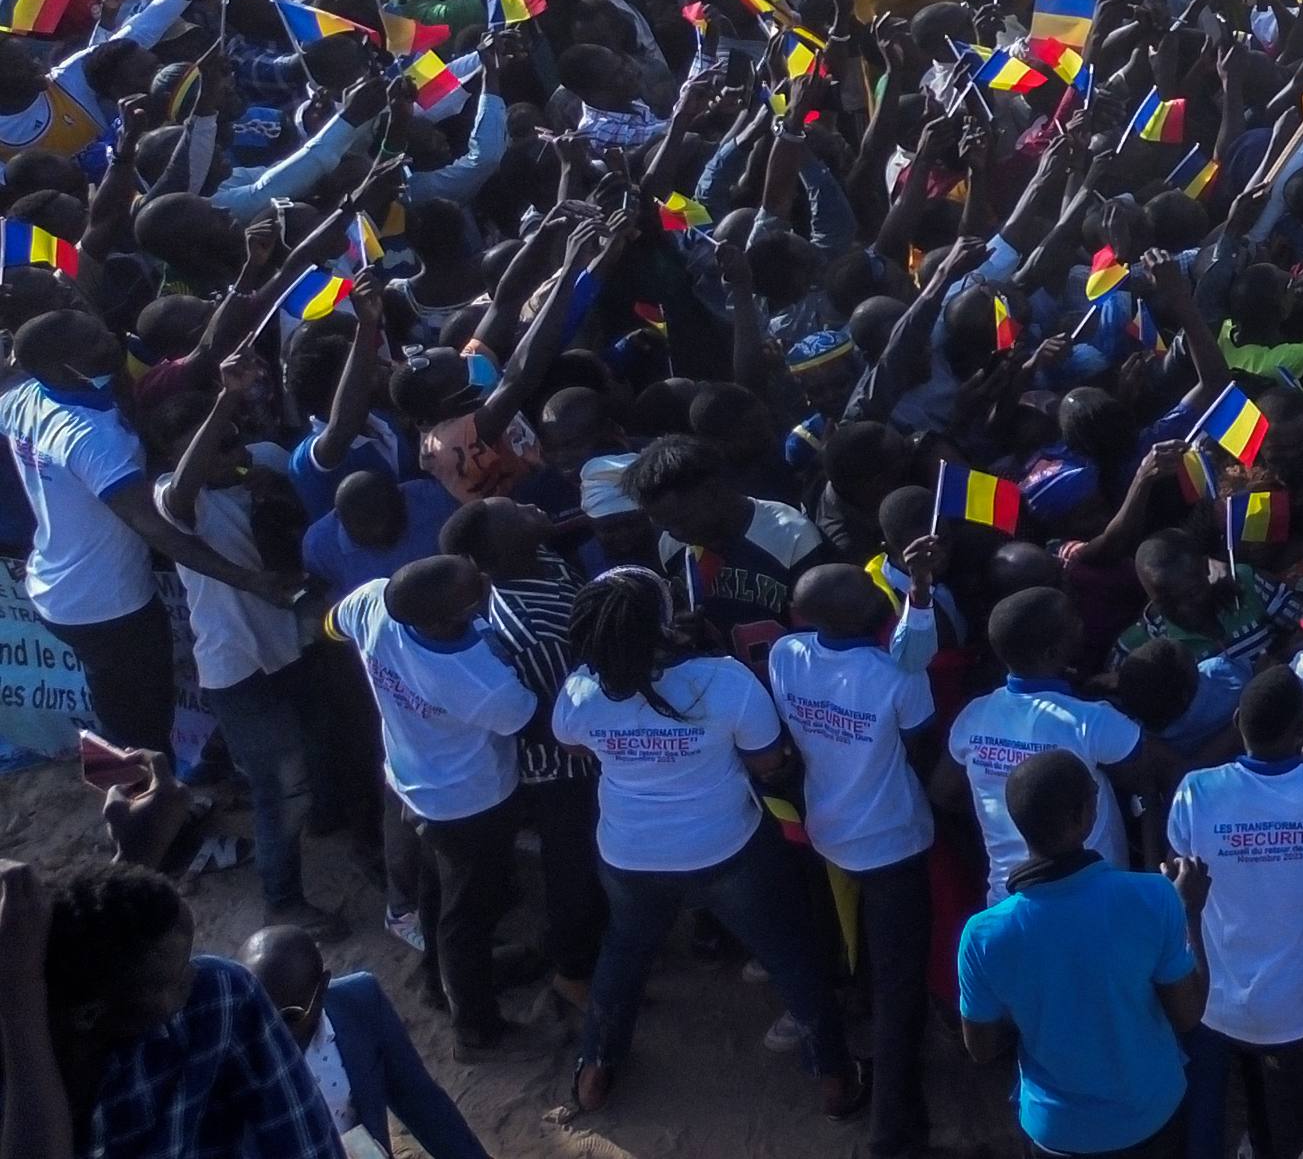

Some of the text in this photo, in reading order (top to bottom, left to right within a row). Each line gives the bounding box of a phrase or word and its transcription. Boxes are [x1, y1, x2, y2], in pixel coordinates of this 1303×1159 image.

[35, 639, 55, 669] le
[32, 679, 77, 710] durs
[589, 727, 706, 738] LES TRANSFORMATEURS
[969, 734, 983, 744] LES
[1213, 823, 1232, 834] LES
